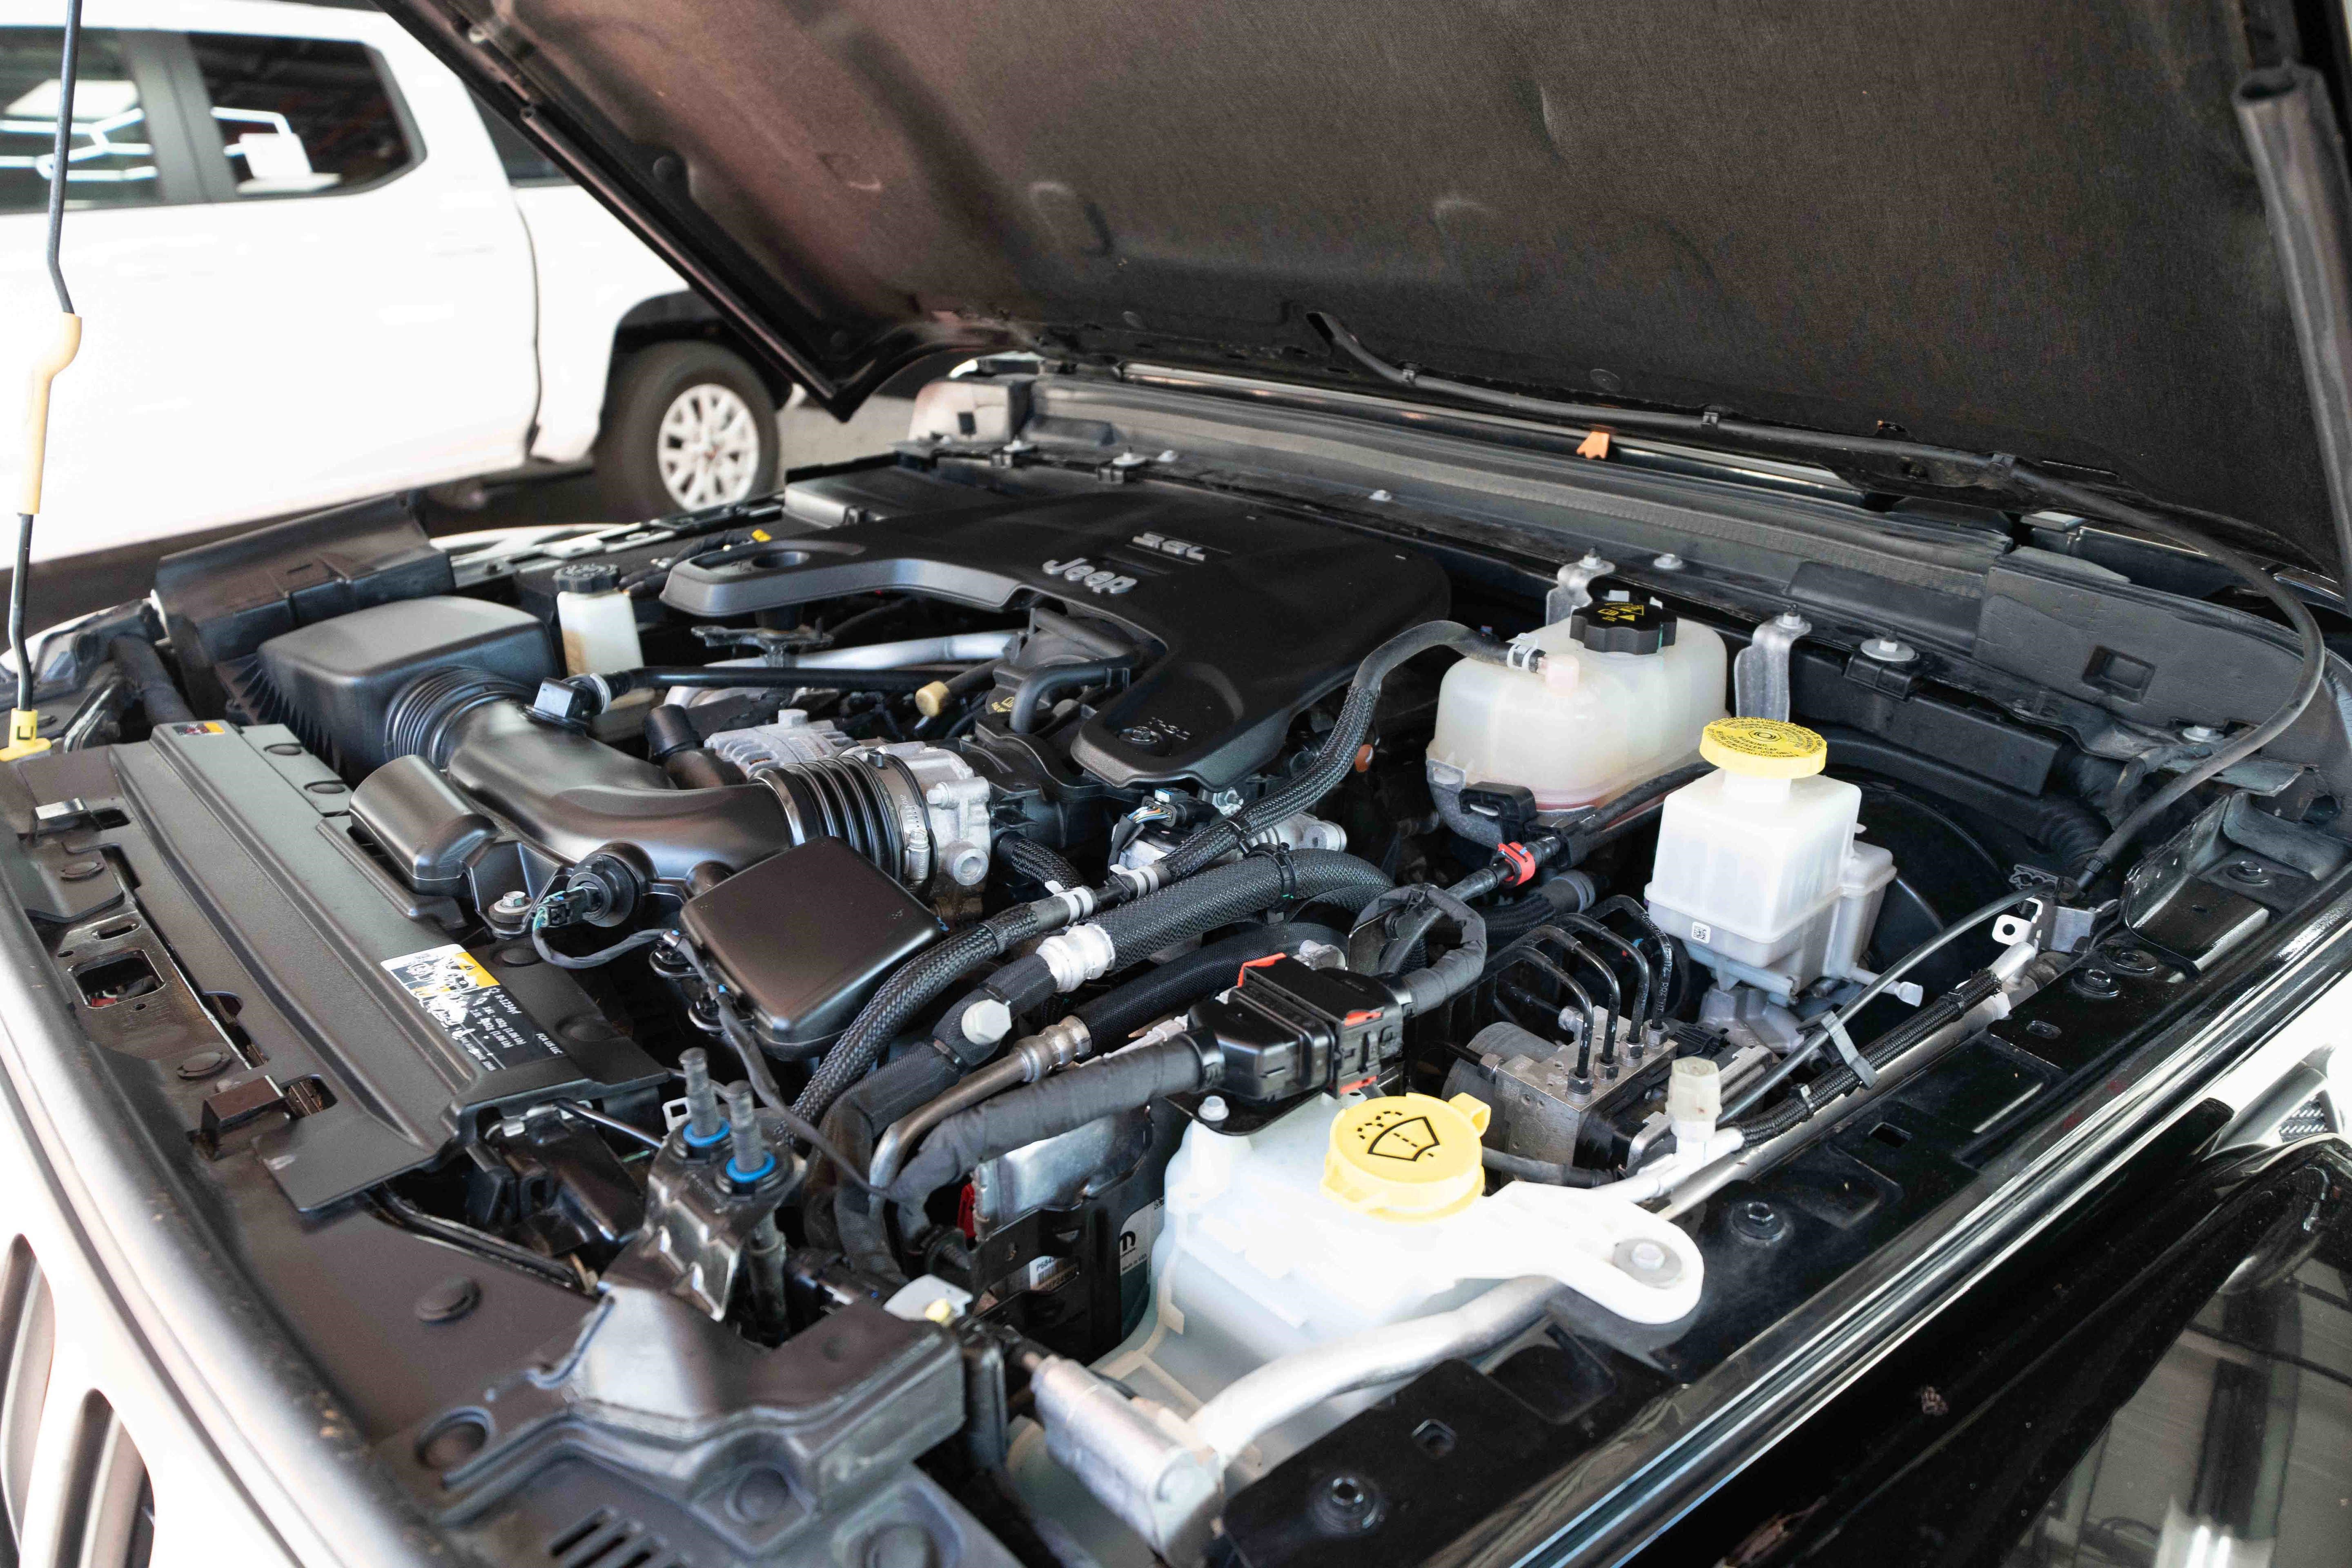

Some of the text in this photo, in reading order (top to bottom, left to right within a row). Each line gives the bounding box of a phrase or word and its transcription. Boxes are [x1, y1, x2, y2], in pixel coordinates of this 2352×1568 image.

[1042, 557, 1137, 593] Jeep
[1737, 736, 1767, 747] WARNING
[536, 1033, 549, 1041] FCA
[549, 1046, 564, 1054] LLC
